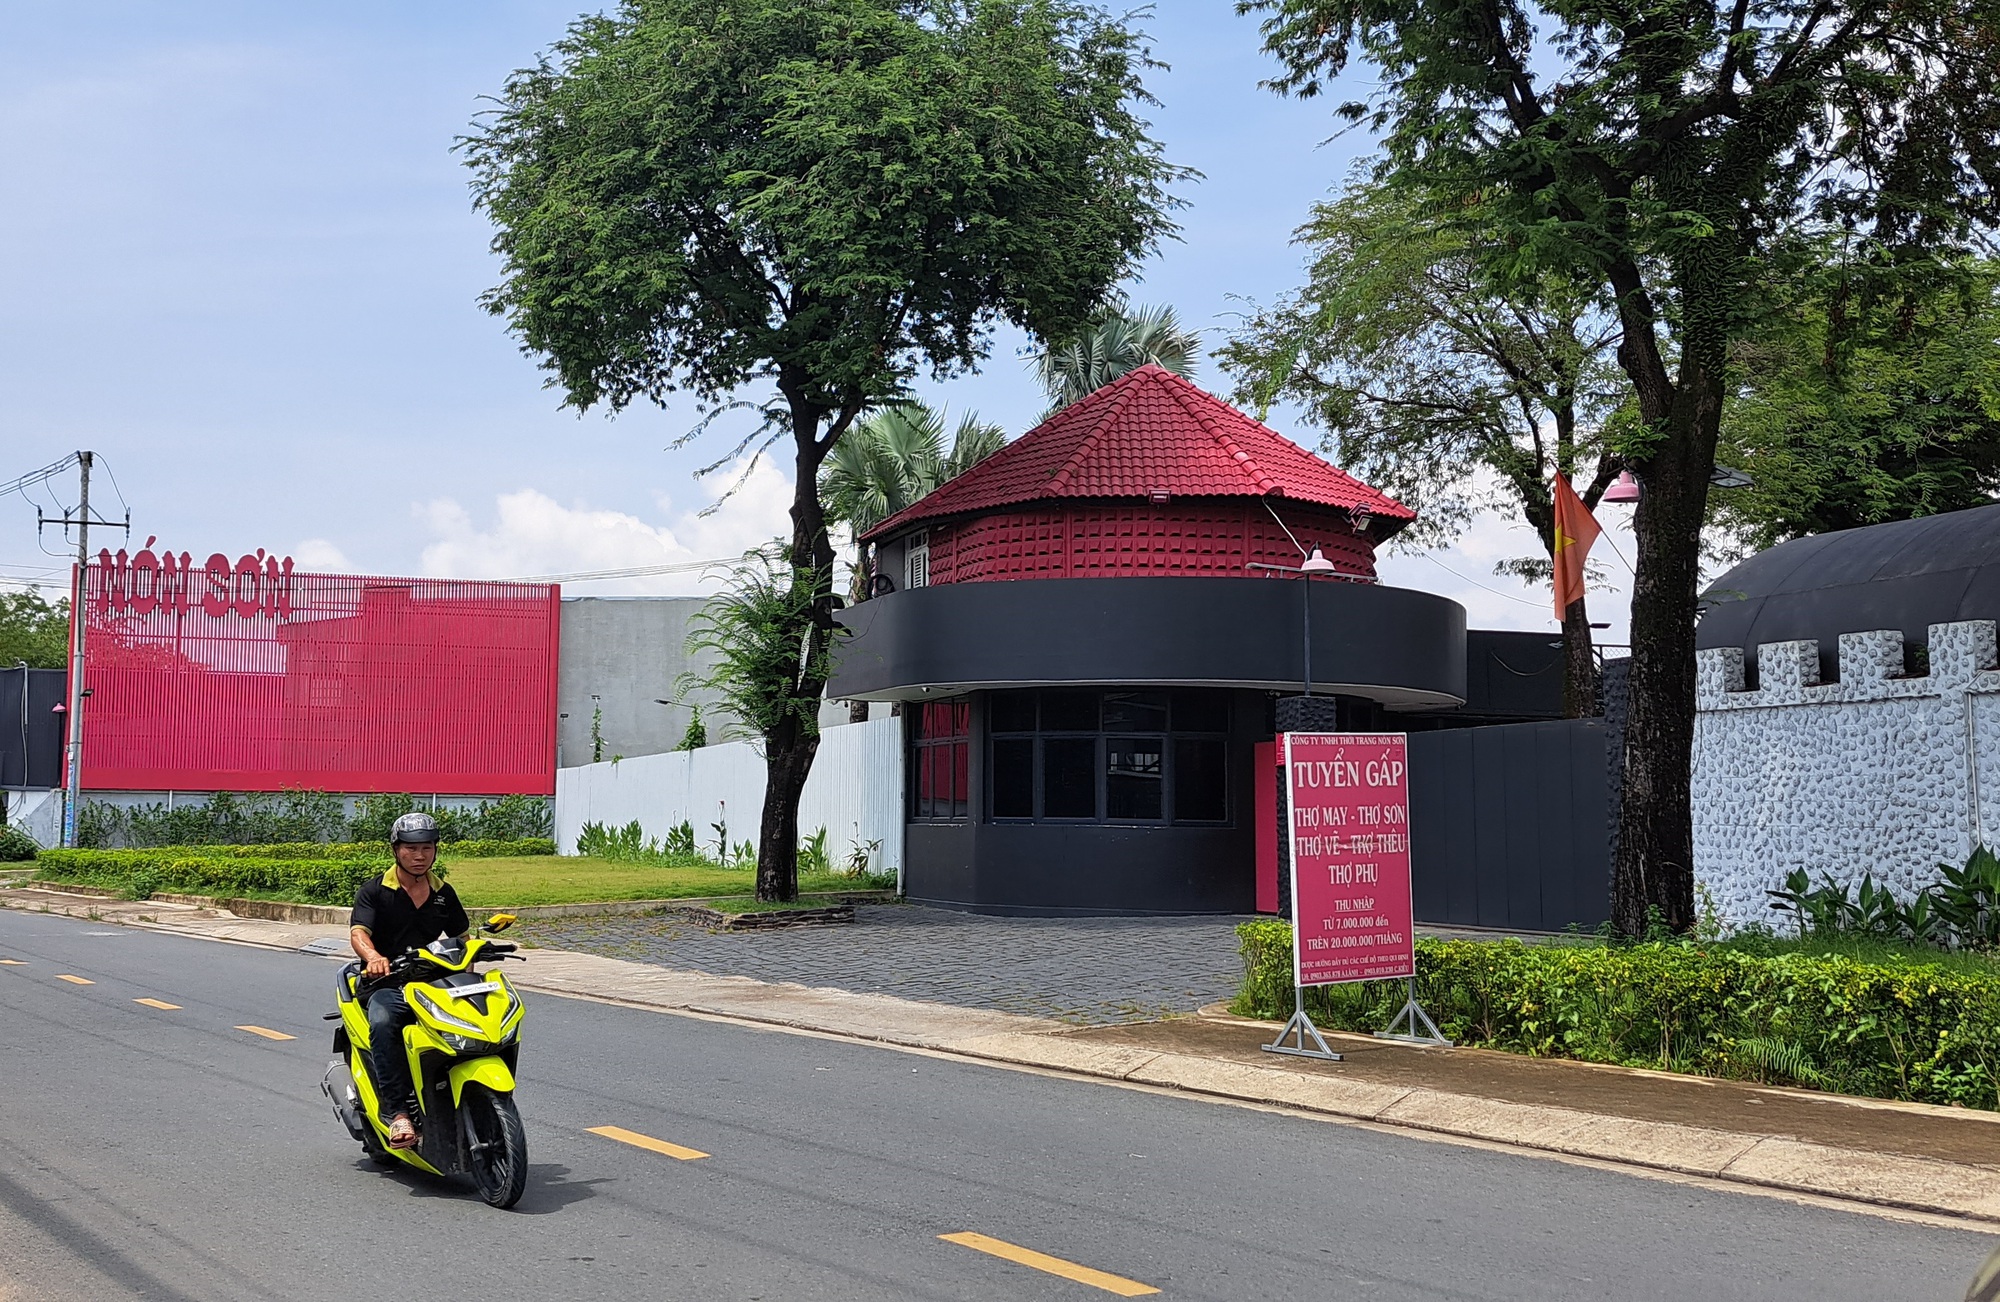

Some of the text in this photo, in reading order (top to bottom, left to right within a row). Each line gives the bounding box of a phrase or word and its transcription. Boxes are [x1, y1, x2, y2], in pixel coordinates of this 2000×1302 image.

[98, 535, 294, 619] NÓN SƠN
[1291, 736, 1309, 745] CÔNG
[1310, 736, 1319, 745] TY
[1320, 736, 1338, 745] TNHH
[1339, 736, 1355, 745] THỜI
[1355, 736, 1377, 745] TRANG
[1392, 736, 1405, 745] SƠN
[1294, 748, 1359, 787] TUYỂN
[1366, 748, 1403, 786] GẤP
[1295, 804, 1320, 831] THỢ
[1322, 807, 1348, 826] MAY
[1357, 802, 1381, 829] THỢ
[1383, 802, 1406, 825] SƠN
[1297, 833, 1322, 860] THỢ
[1324, 830, 1341, 856] VẼ
[1350, 831, 1375, 859] THỢ
[1376, 827, 1406, 853] THÊU
[1328, 861, 1379, 889] THỢ PHỤ
[1334, 899, 1351, 910] THU
[1323, 913, 1389, 930] TỪ 7.000.000 đến
[1307, 935, 1329, 950] TRÊN
